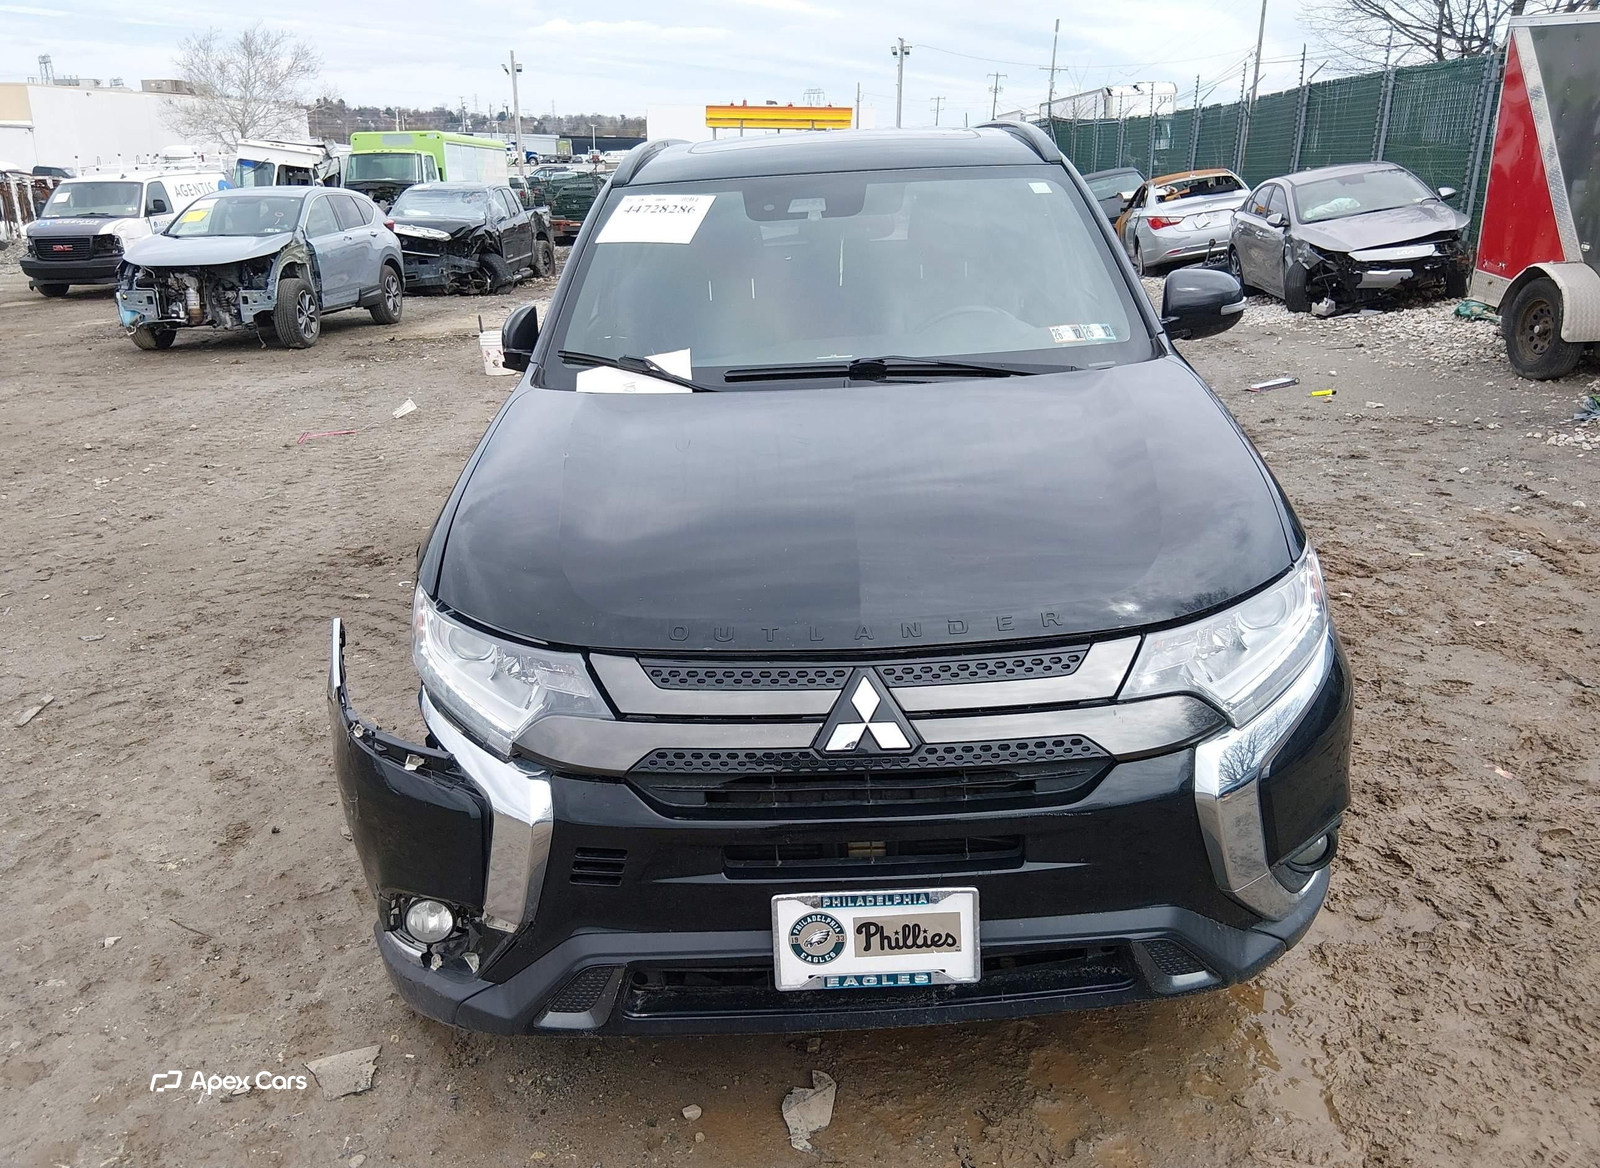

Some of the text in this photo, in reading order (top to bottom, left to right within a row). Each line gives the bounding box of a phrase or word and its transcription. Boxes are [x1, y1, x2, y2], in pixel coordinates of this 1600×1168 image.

[174, 182, 216, 198] AGENTIS
[52, 244, 73, 252] GMC
[667, 610, 1064, 643] OUTLANDER
[822, 893, 928, 908] PHILADELPHIA
[793, 914, 841, 935] PHILADELPHIA
[856, 921, 957, 951] Phillies
[800, 951, 836, 963] EAGLES
[827, 974, 929, 987] EAGLES
